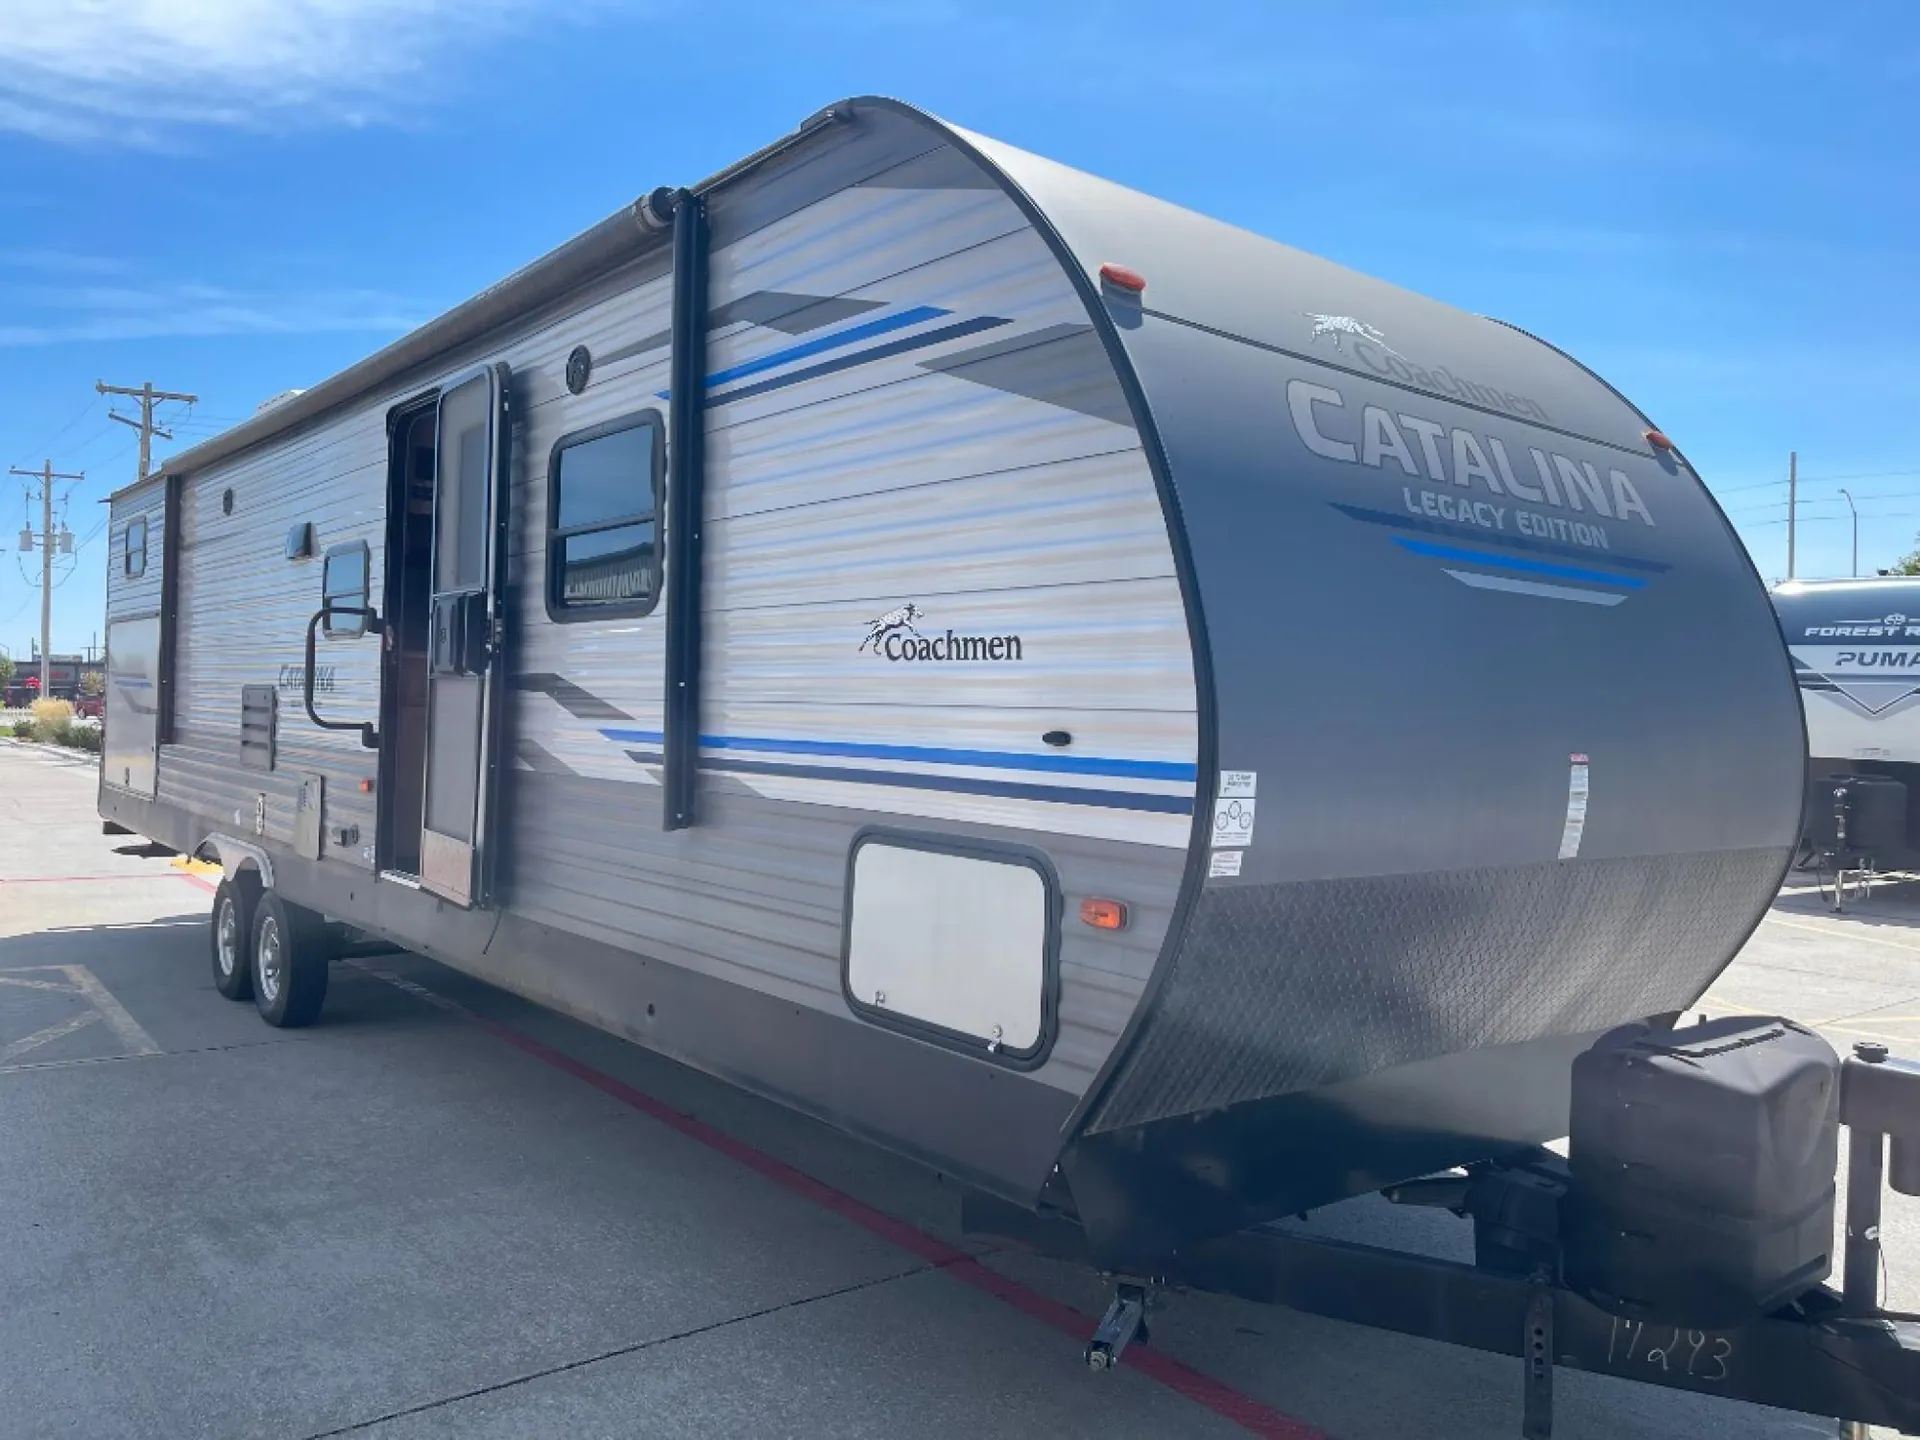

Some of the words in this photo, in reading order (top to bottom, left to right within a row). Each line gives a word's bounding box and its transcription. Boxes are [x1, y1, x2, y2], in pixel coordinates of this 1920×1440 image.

[1353, 341, 1550, 422] Coachmen
[1285, 379, 1655, 527] CATALINA
[1402, 487, 1506, 530] LEGACY
[1515, 509, 1609, 550] EDITION
[884, 629, 1023, 662] Coachmen
[1804, 625, 1900, 637] FOREST
